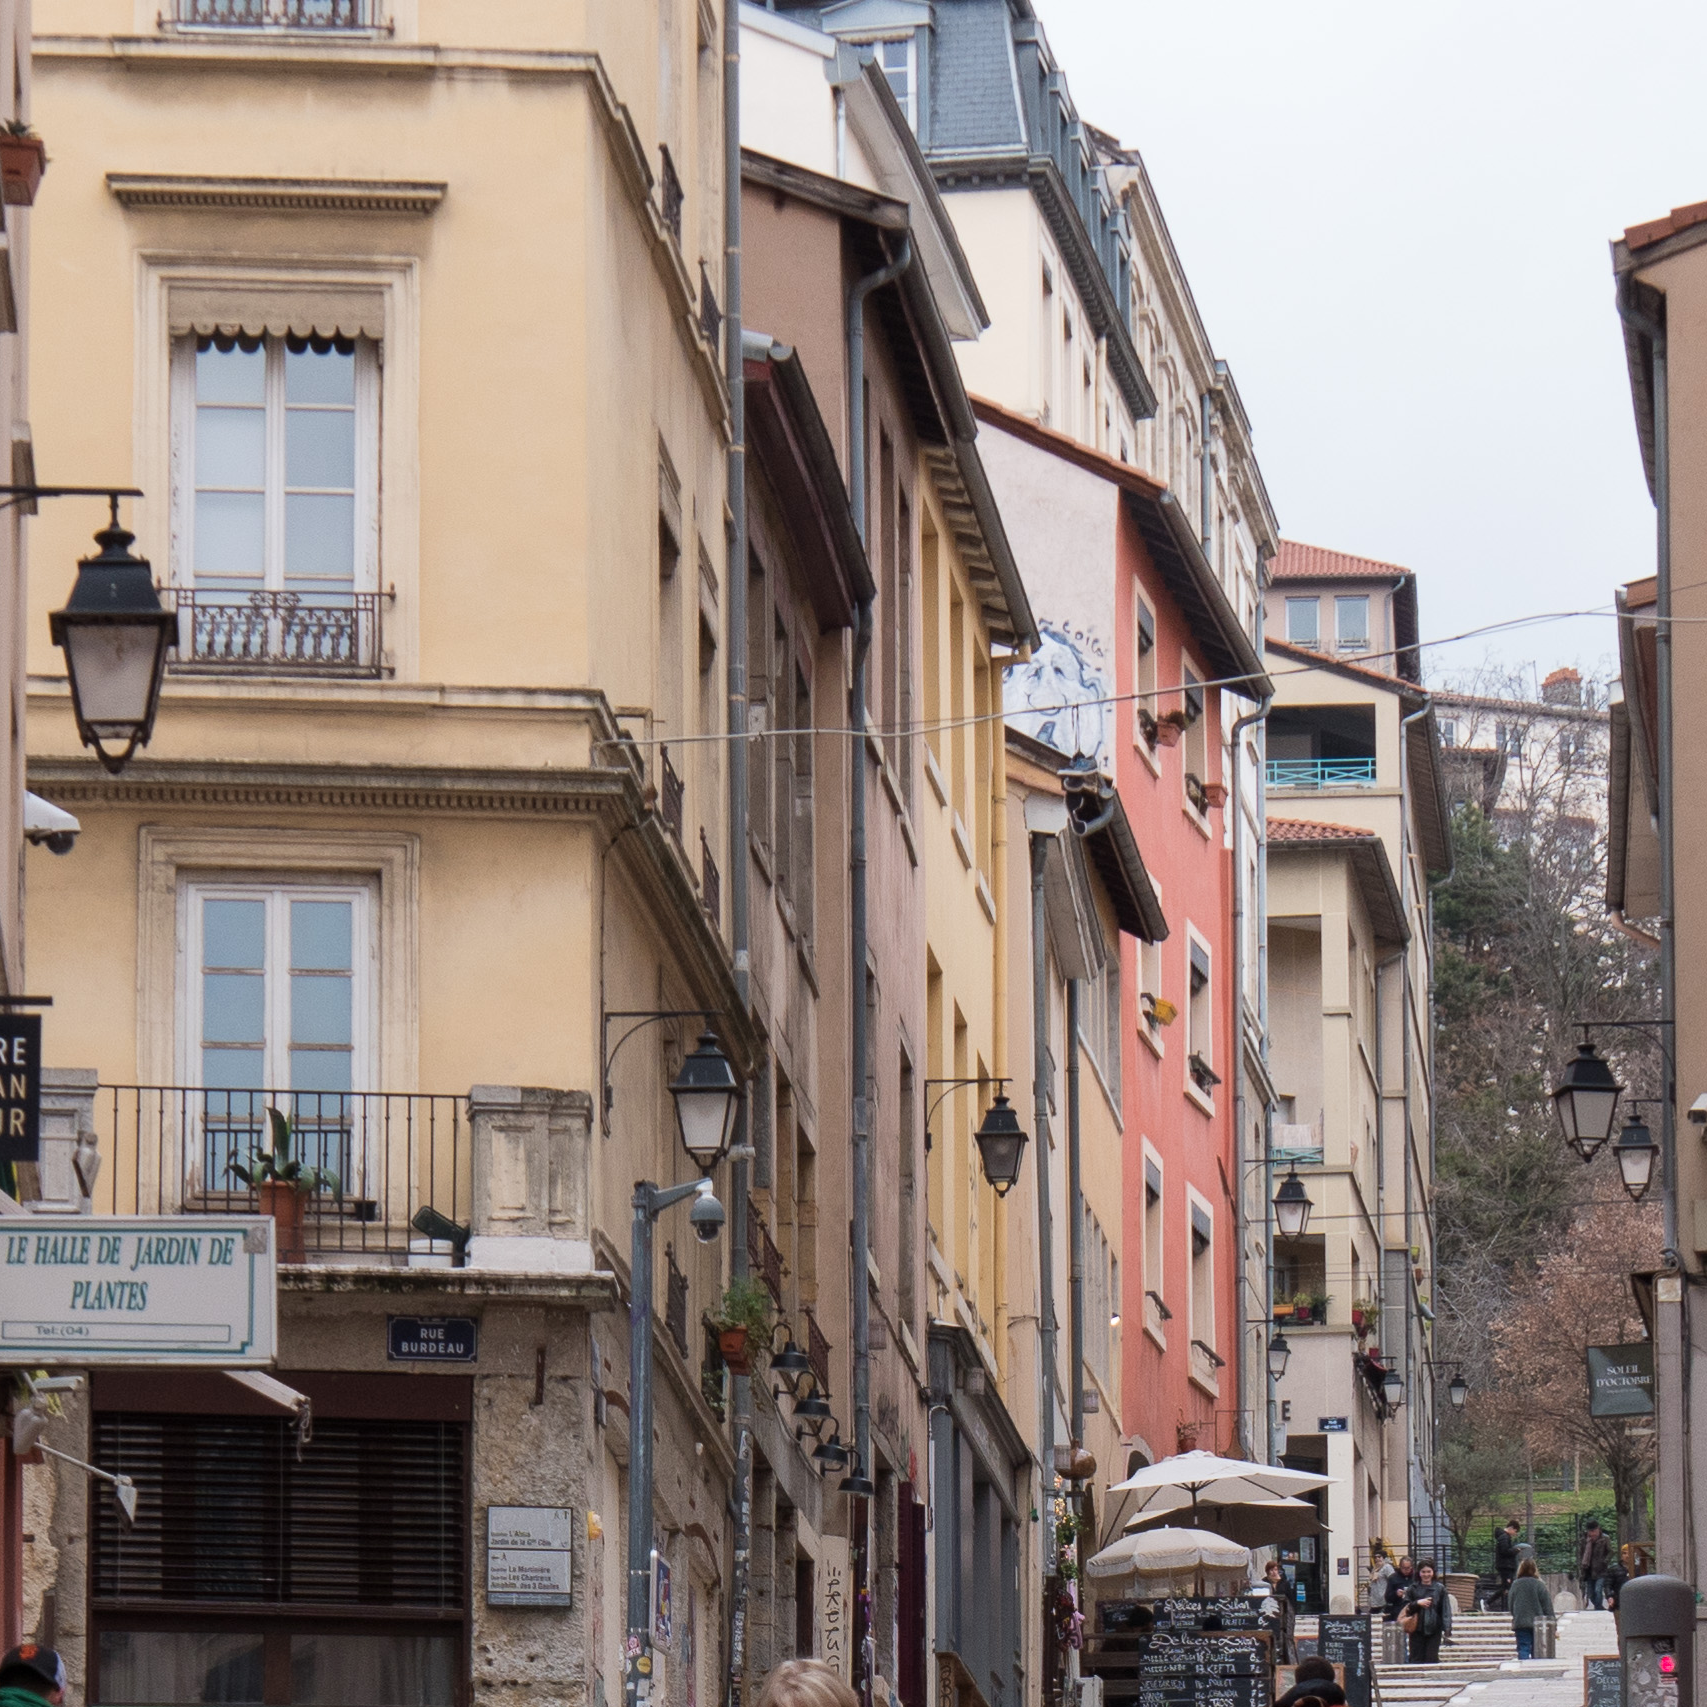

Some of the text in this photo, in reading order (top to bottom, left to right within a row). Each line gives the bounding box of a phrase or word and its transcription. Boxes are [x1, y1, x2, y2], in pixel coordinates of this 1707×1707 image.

[5, 1235, 235, 1272] LE HALLE DE JARDIN DE
[70, 1280, 149, 1311] PLANTES
[420, 1328, 446, 1340] RUE
[401, 1341, 465, 1355] BURDEAU
[1606, 1364, 1642, 1376] SOLEIL
[1595, 1375, 1654, 1389] D'OCTOBRE
